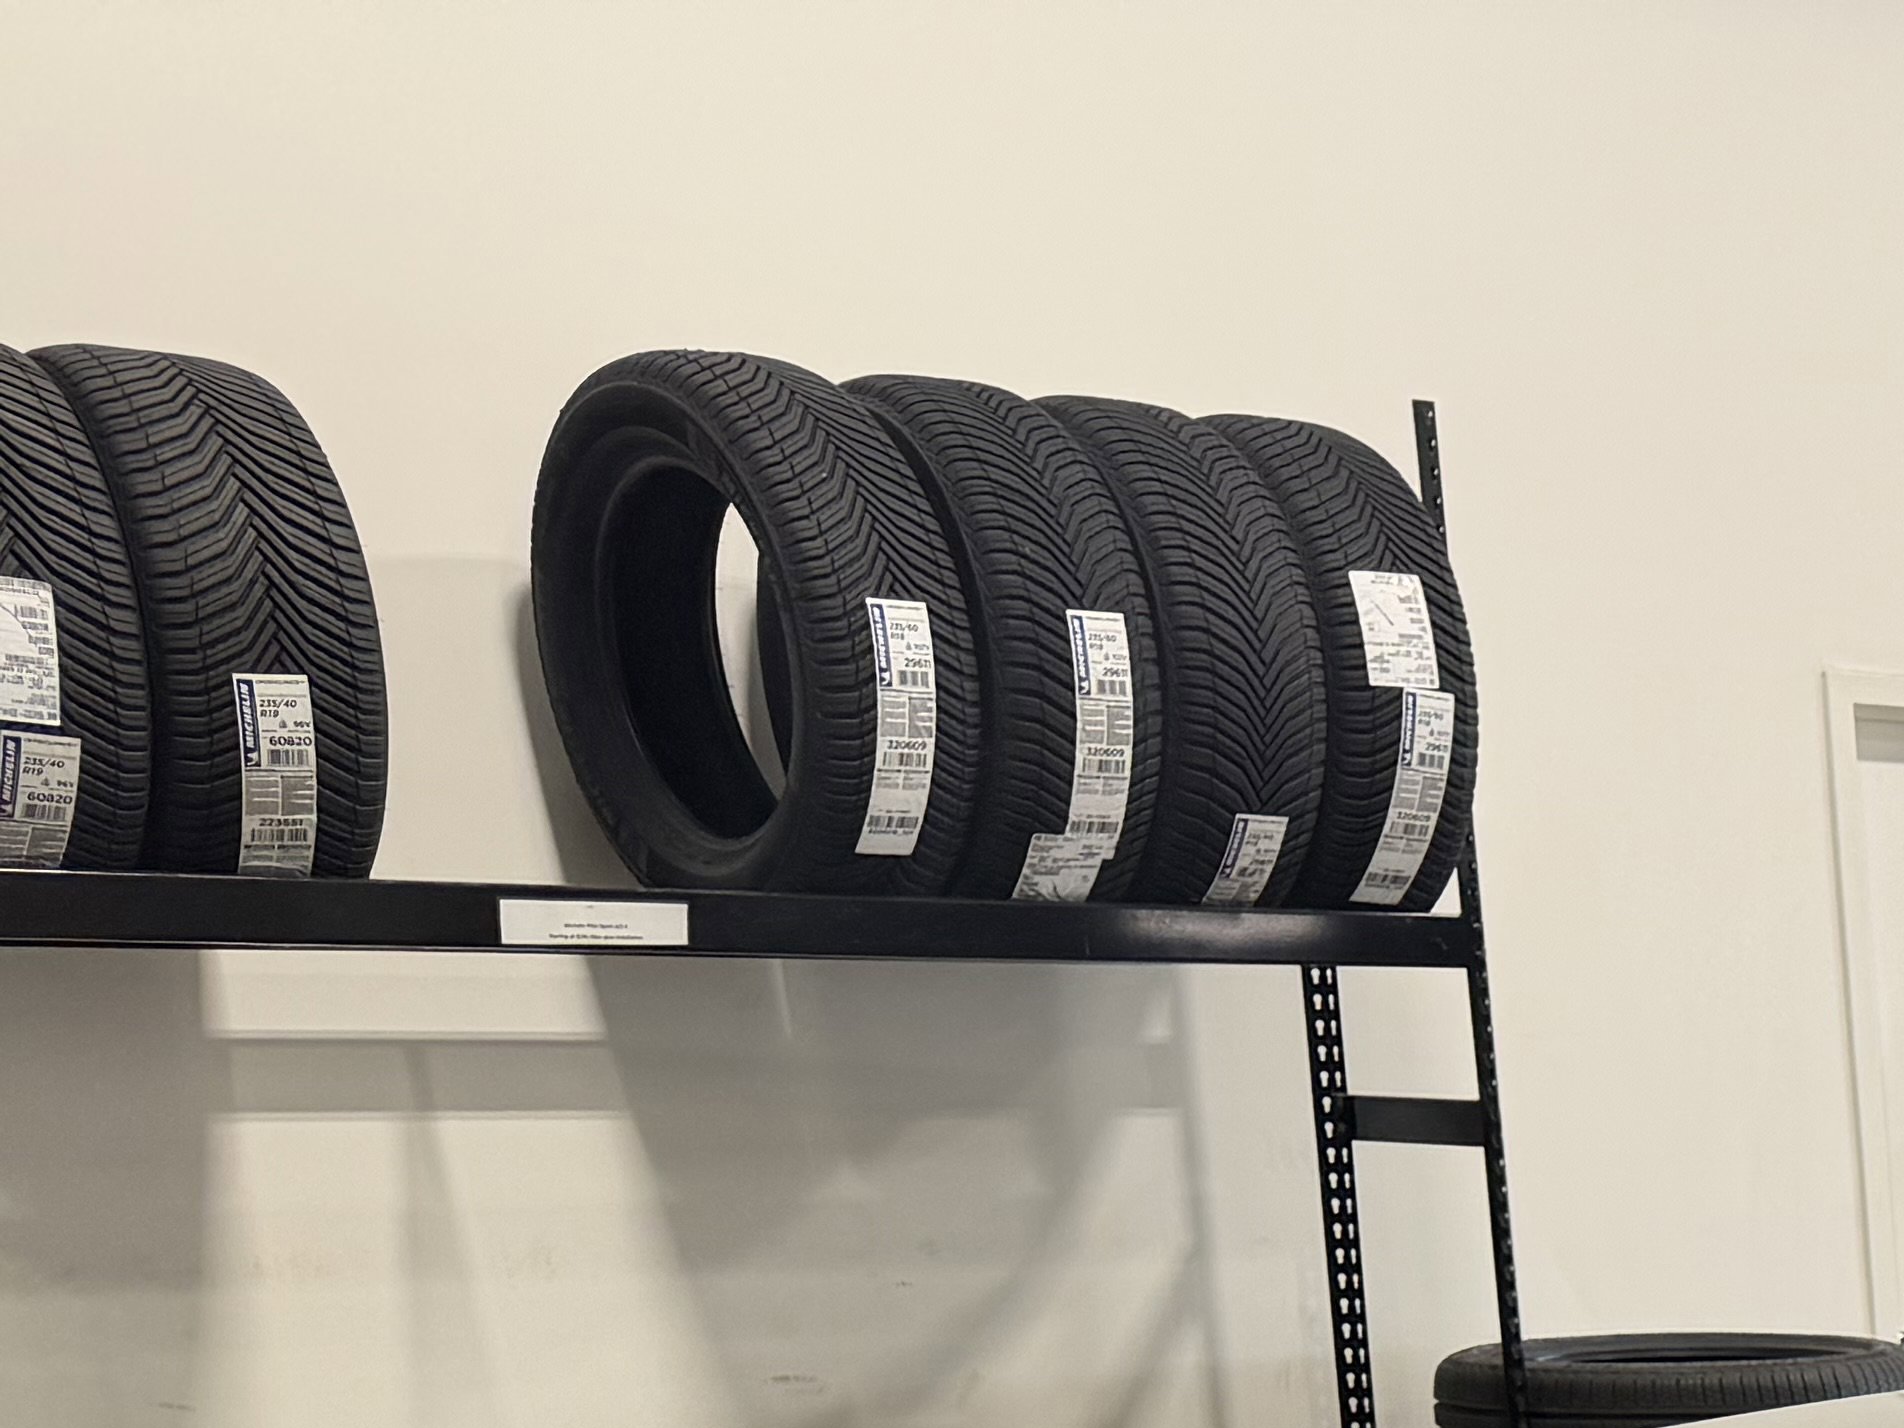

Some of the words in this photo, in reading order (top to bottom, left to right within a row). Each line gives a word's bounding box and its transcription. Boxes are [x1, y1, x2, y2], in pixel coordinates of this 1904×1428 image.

[259, 699, 297, 708] 235/40
[240, 682, 255, 748] MICHELIN
[269, 736, 312, 746] 60820
[23, 756, 65, 768] 235/40
[2, 739, 16, 801] MICHELIN
[27, 791, 73, 805] 60820
